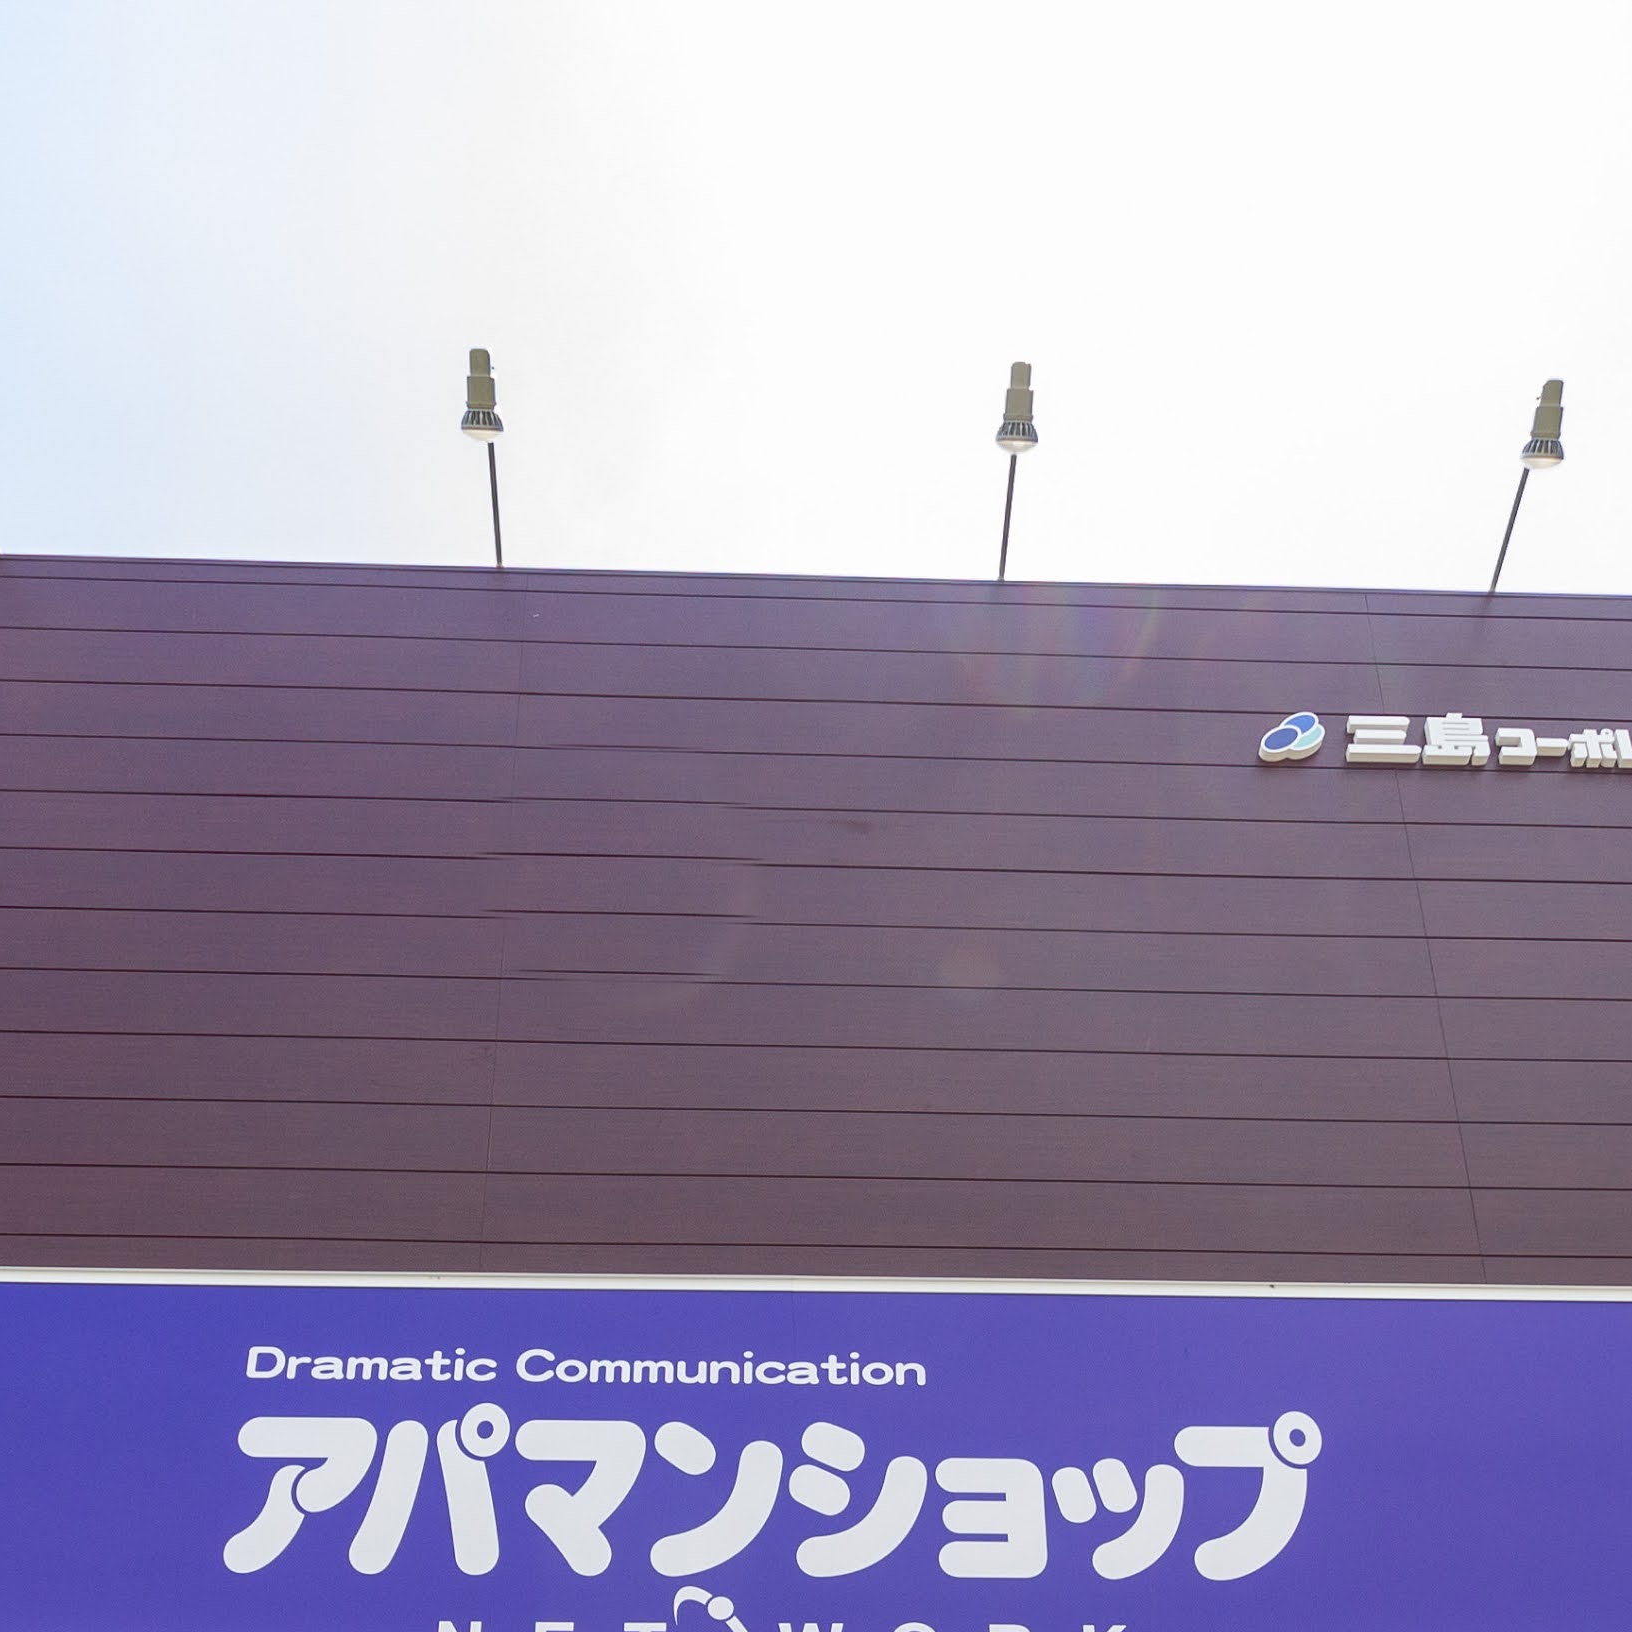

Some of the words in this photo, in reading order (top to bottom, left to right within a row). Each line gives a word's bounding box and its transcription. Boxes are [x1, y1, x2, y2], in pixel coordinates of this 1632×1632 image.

[245, 1346, 498, 1382] Dramatic
[515, 1348, 927, 1386] Communication
[222, 1402, 1323, 1581] アパマンショップ
